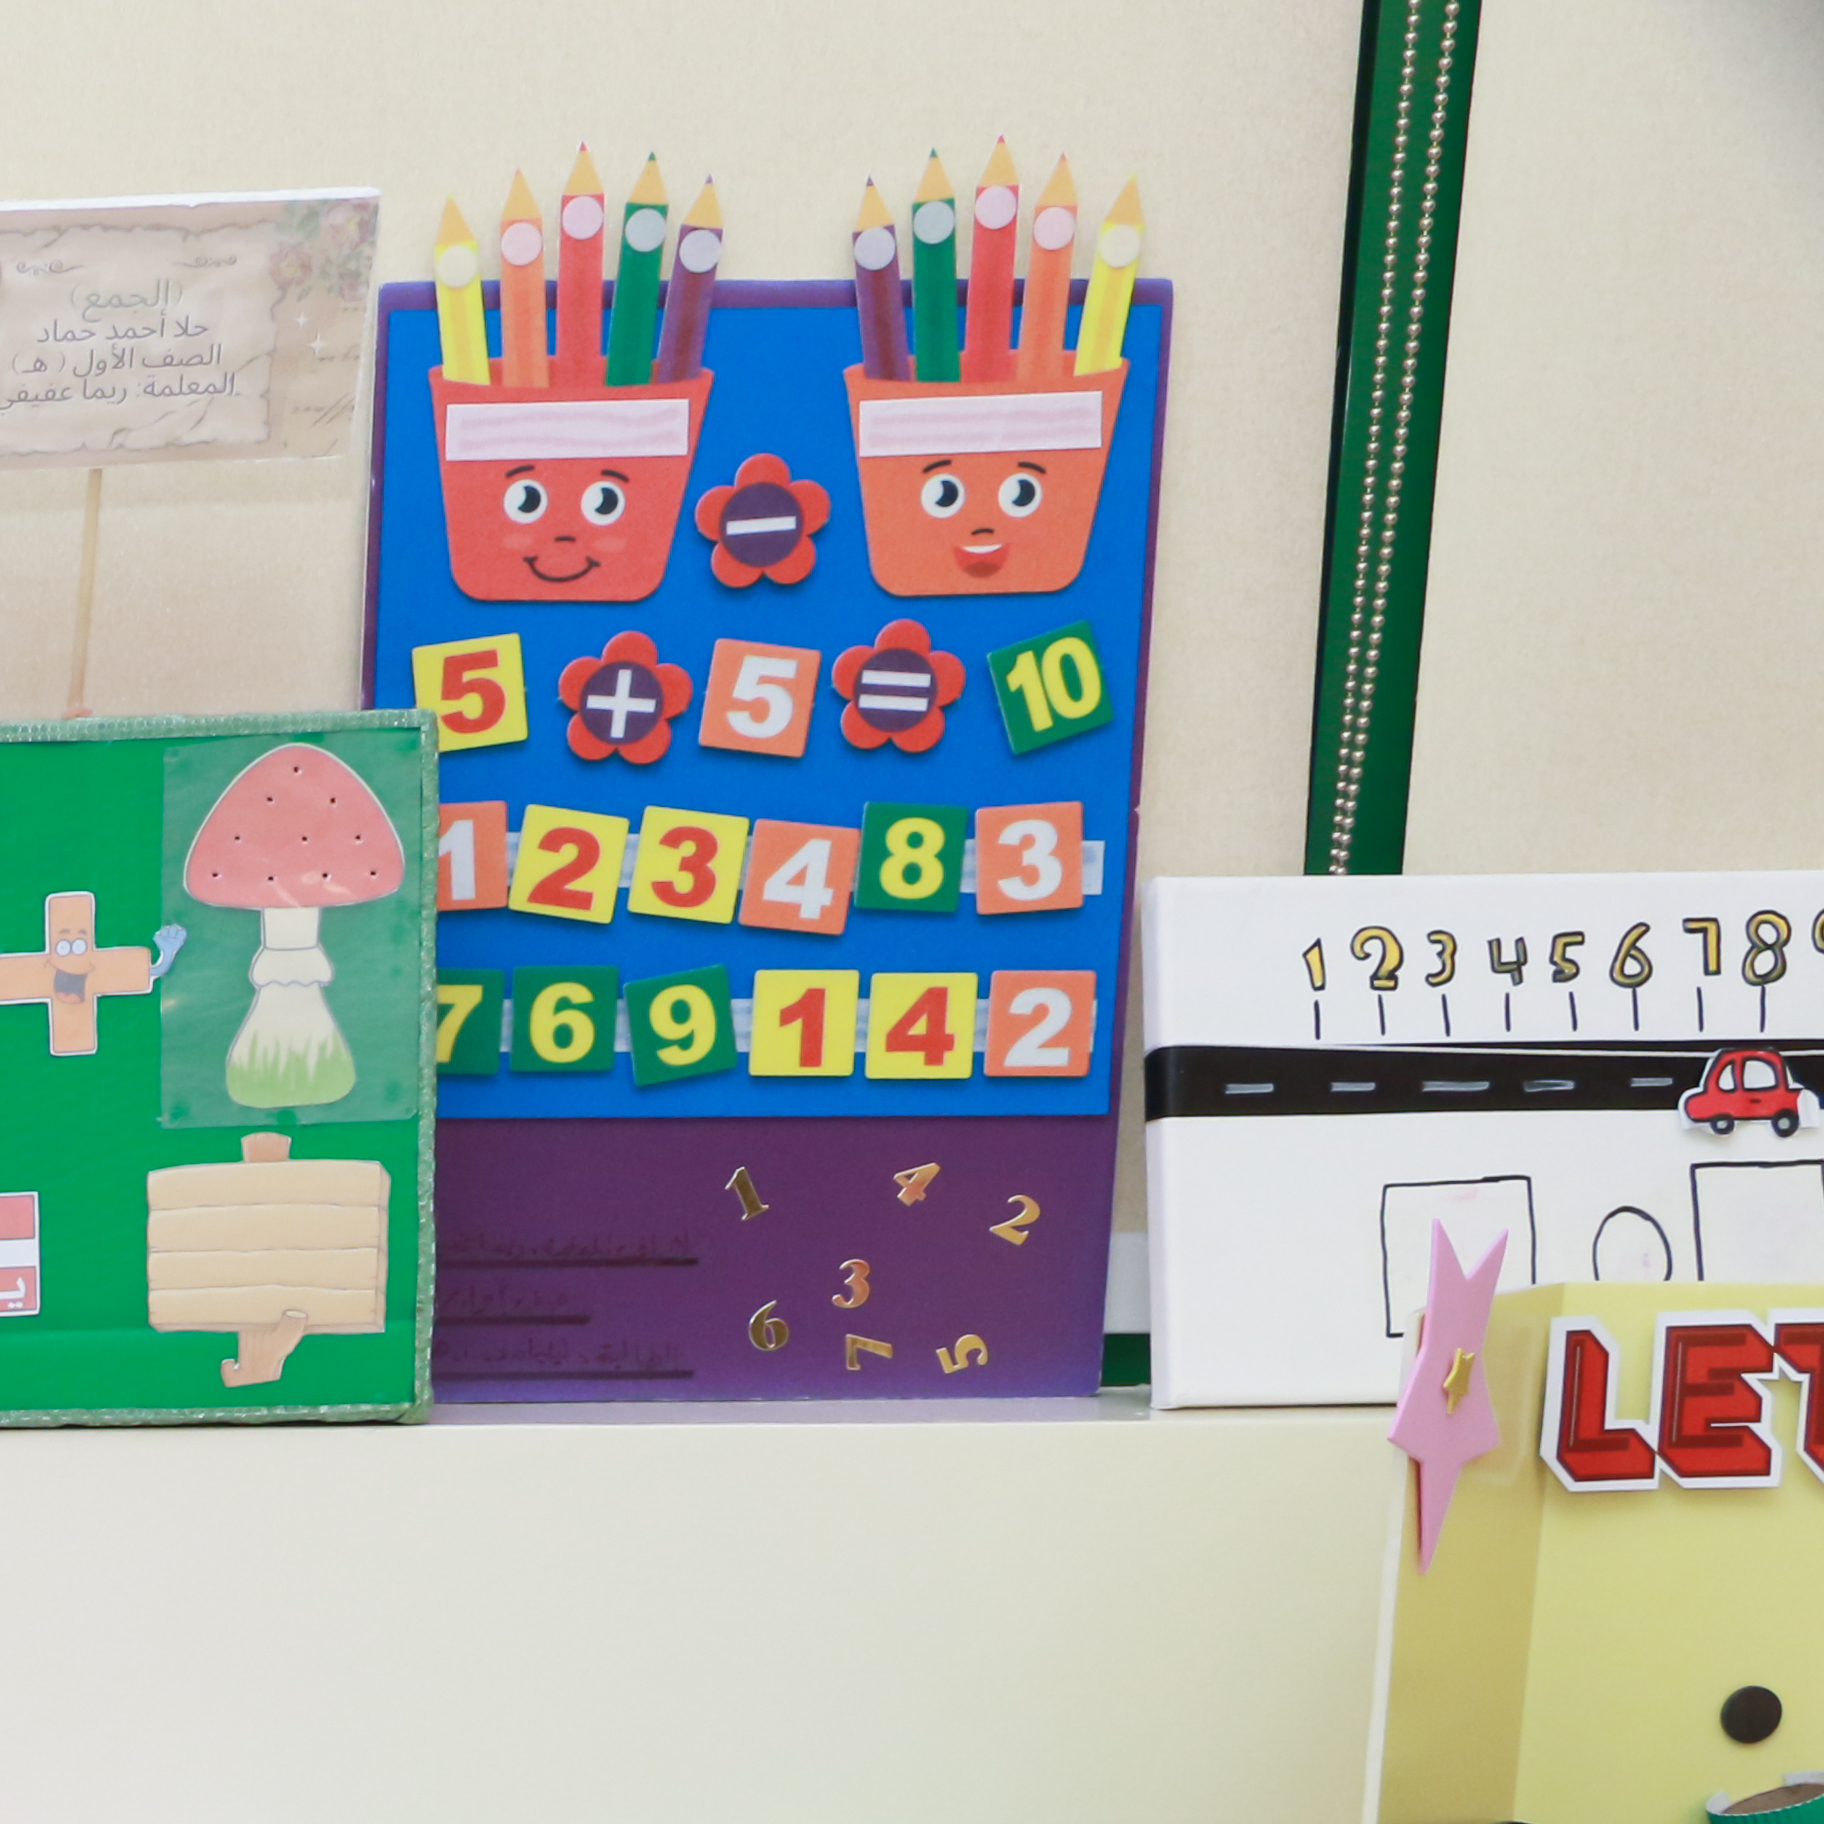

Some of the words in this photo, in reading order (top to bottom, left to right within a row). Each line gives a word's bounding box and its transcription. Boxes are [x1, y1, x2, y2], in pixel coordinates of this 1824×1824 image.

[73, 344, 134, 377] الأول
[106, 308, 165, 340] أحمد
[142, 343, 222, 369] الصف
[438, 650, 506, 735] 5
[725, 655, 799, 739] 5
[1006, 638, 1101, 733] 10
[528, 826, 603, 911] 2
[651, 826, 720, 908] 3
[762, 839, 834, 920] 4
[879, 817, 946, 899] 8
[997, 819, 1064, 901] 3
[1302, 937, 1327, 991] 1
[1351, 926, 1403, 992] 2
[1425, 930, 1456, 987] 3
[1488, 935, 1527, 986] 4
[1551, 930, 1585, 983] 5
[1609, 922, 1653, 988] 6
[1682, 917, 1722, 976] 7
[1742, 910, 1792, 986] 8
[529, 982, 595, 1062] 6
[649, 984, 717, 1067] 9
